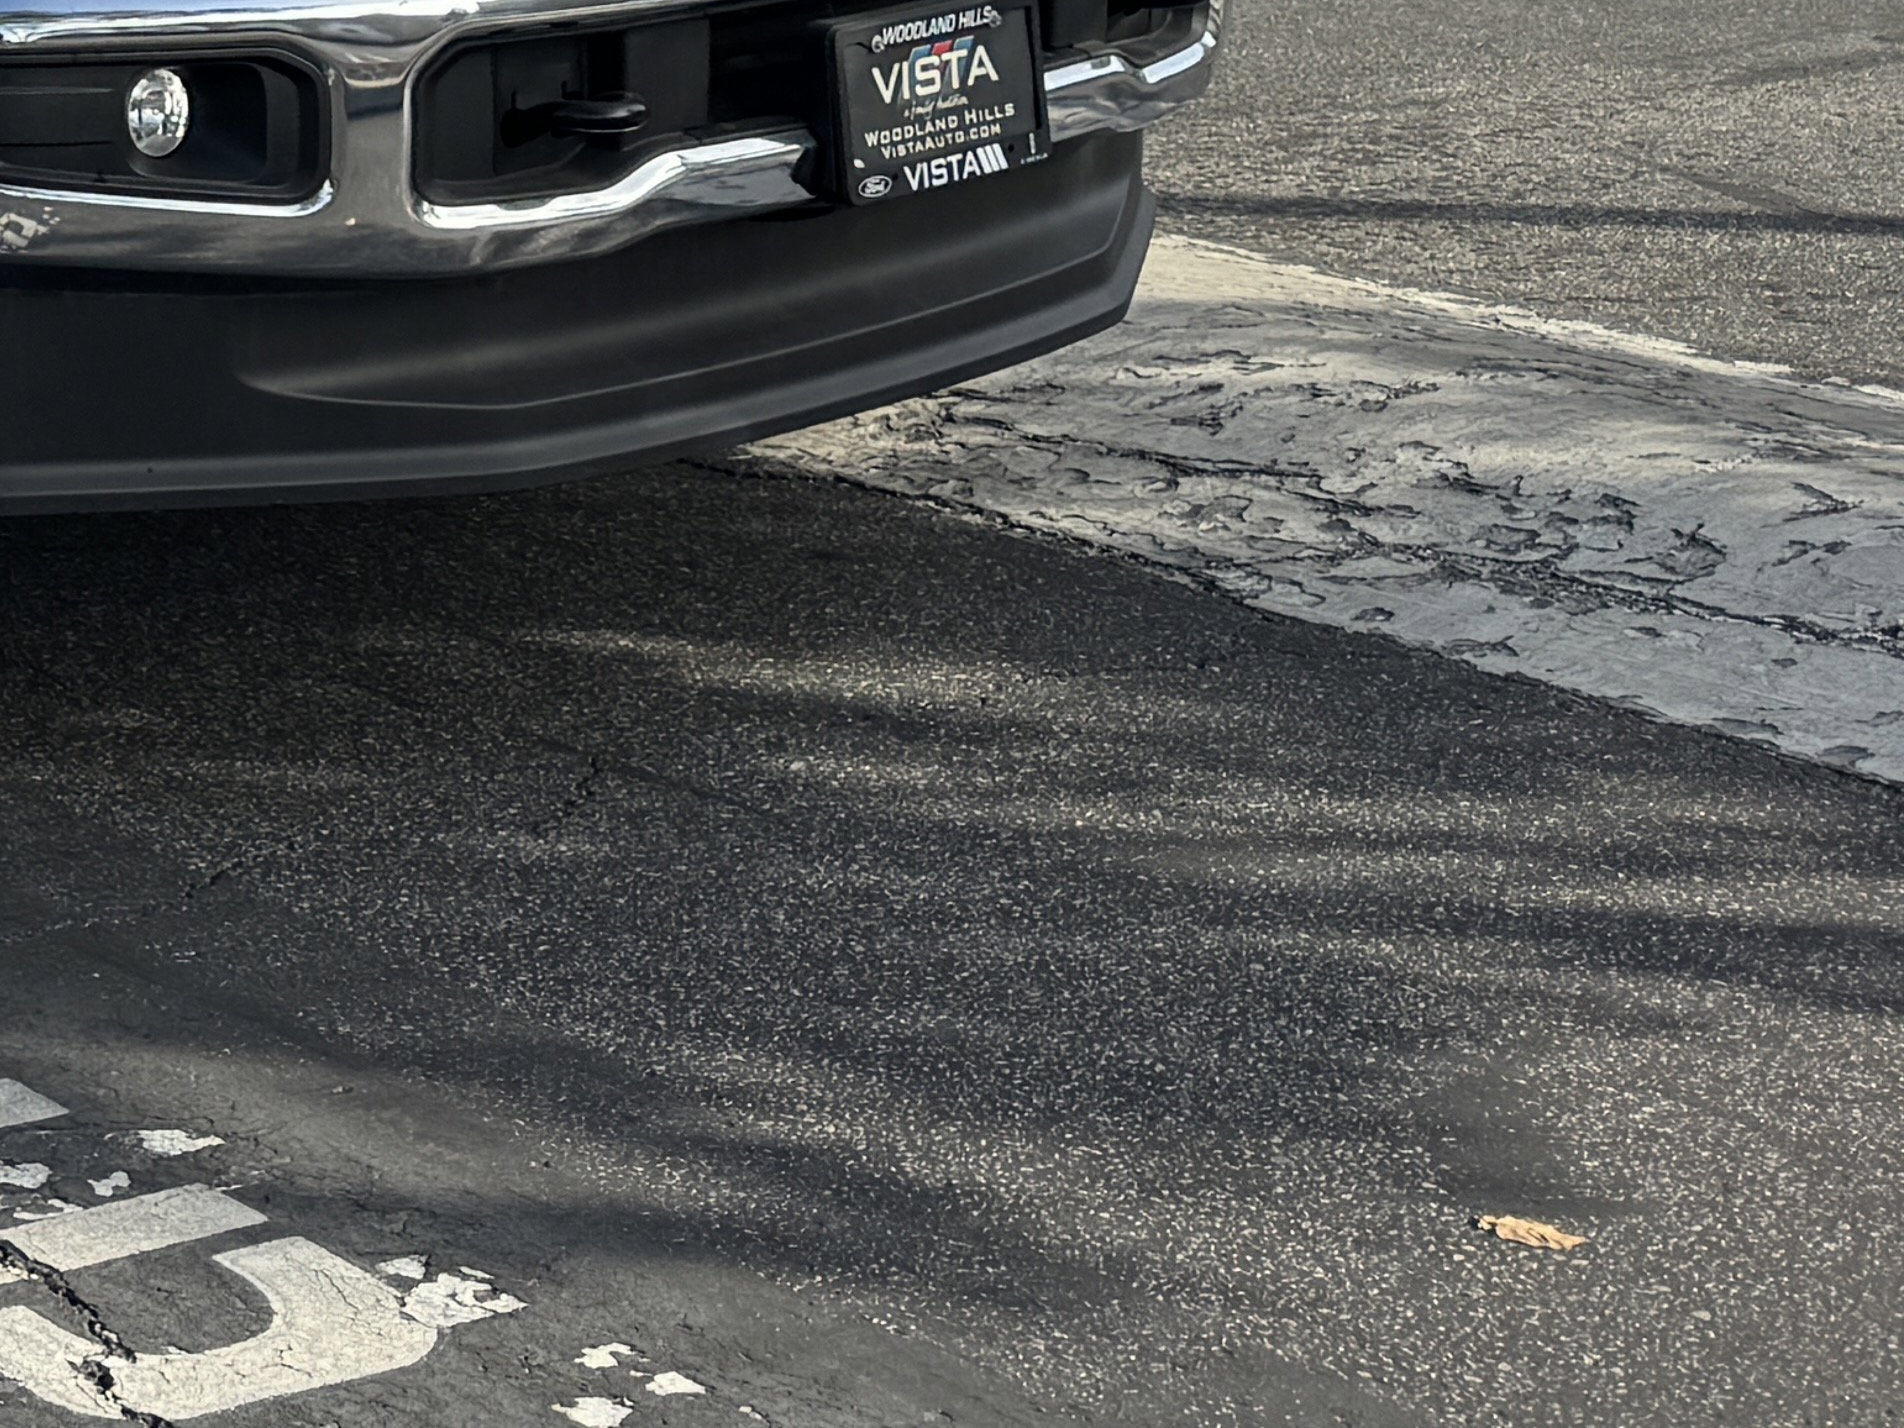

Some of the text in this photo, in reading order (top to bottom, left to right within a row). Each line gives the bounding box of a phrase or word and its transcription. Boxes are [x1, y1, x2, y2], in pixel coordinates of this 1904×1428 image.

[881, 5, 993, 45] WOODLAND HILLS
[871, 44, 1000, 104] VISTA
[864, 115, 959, 148] WOODLAND
[964, 102, 1016, 125] HILLS
[903, 150, 980, 192] VISTA
